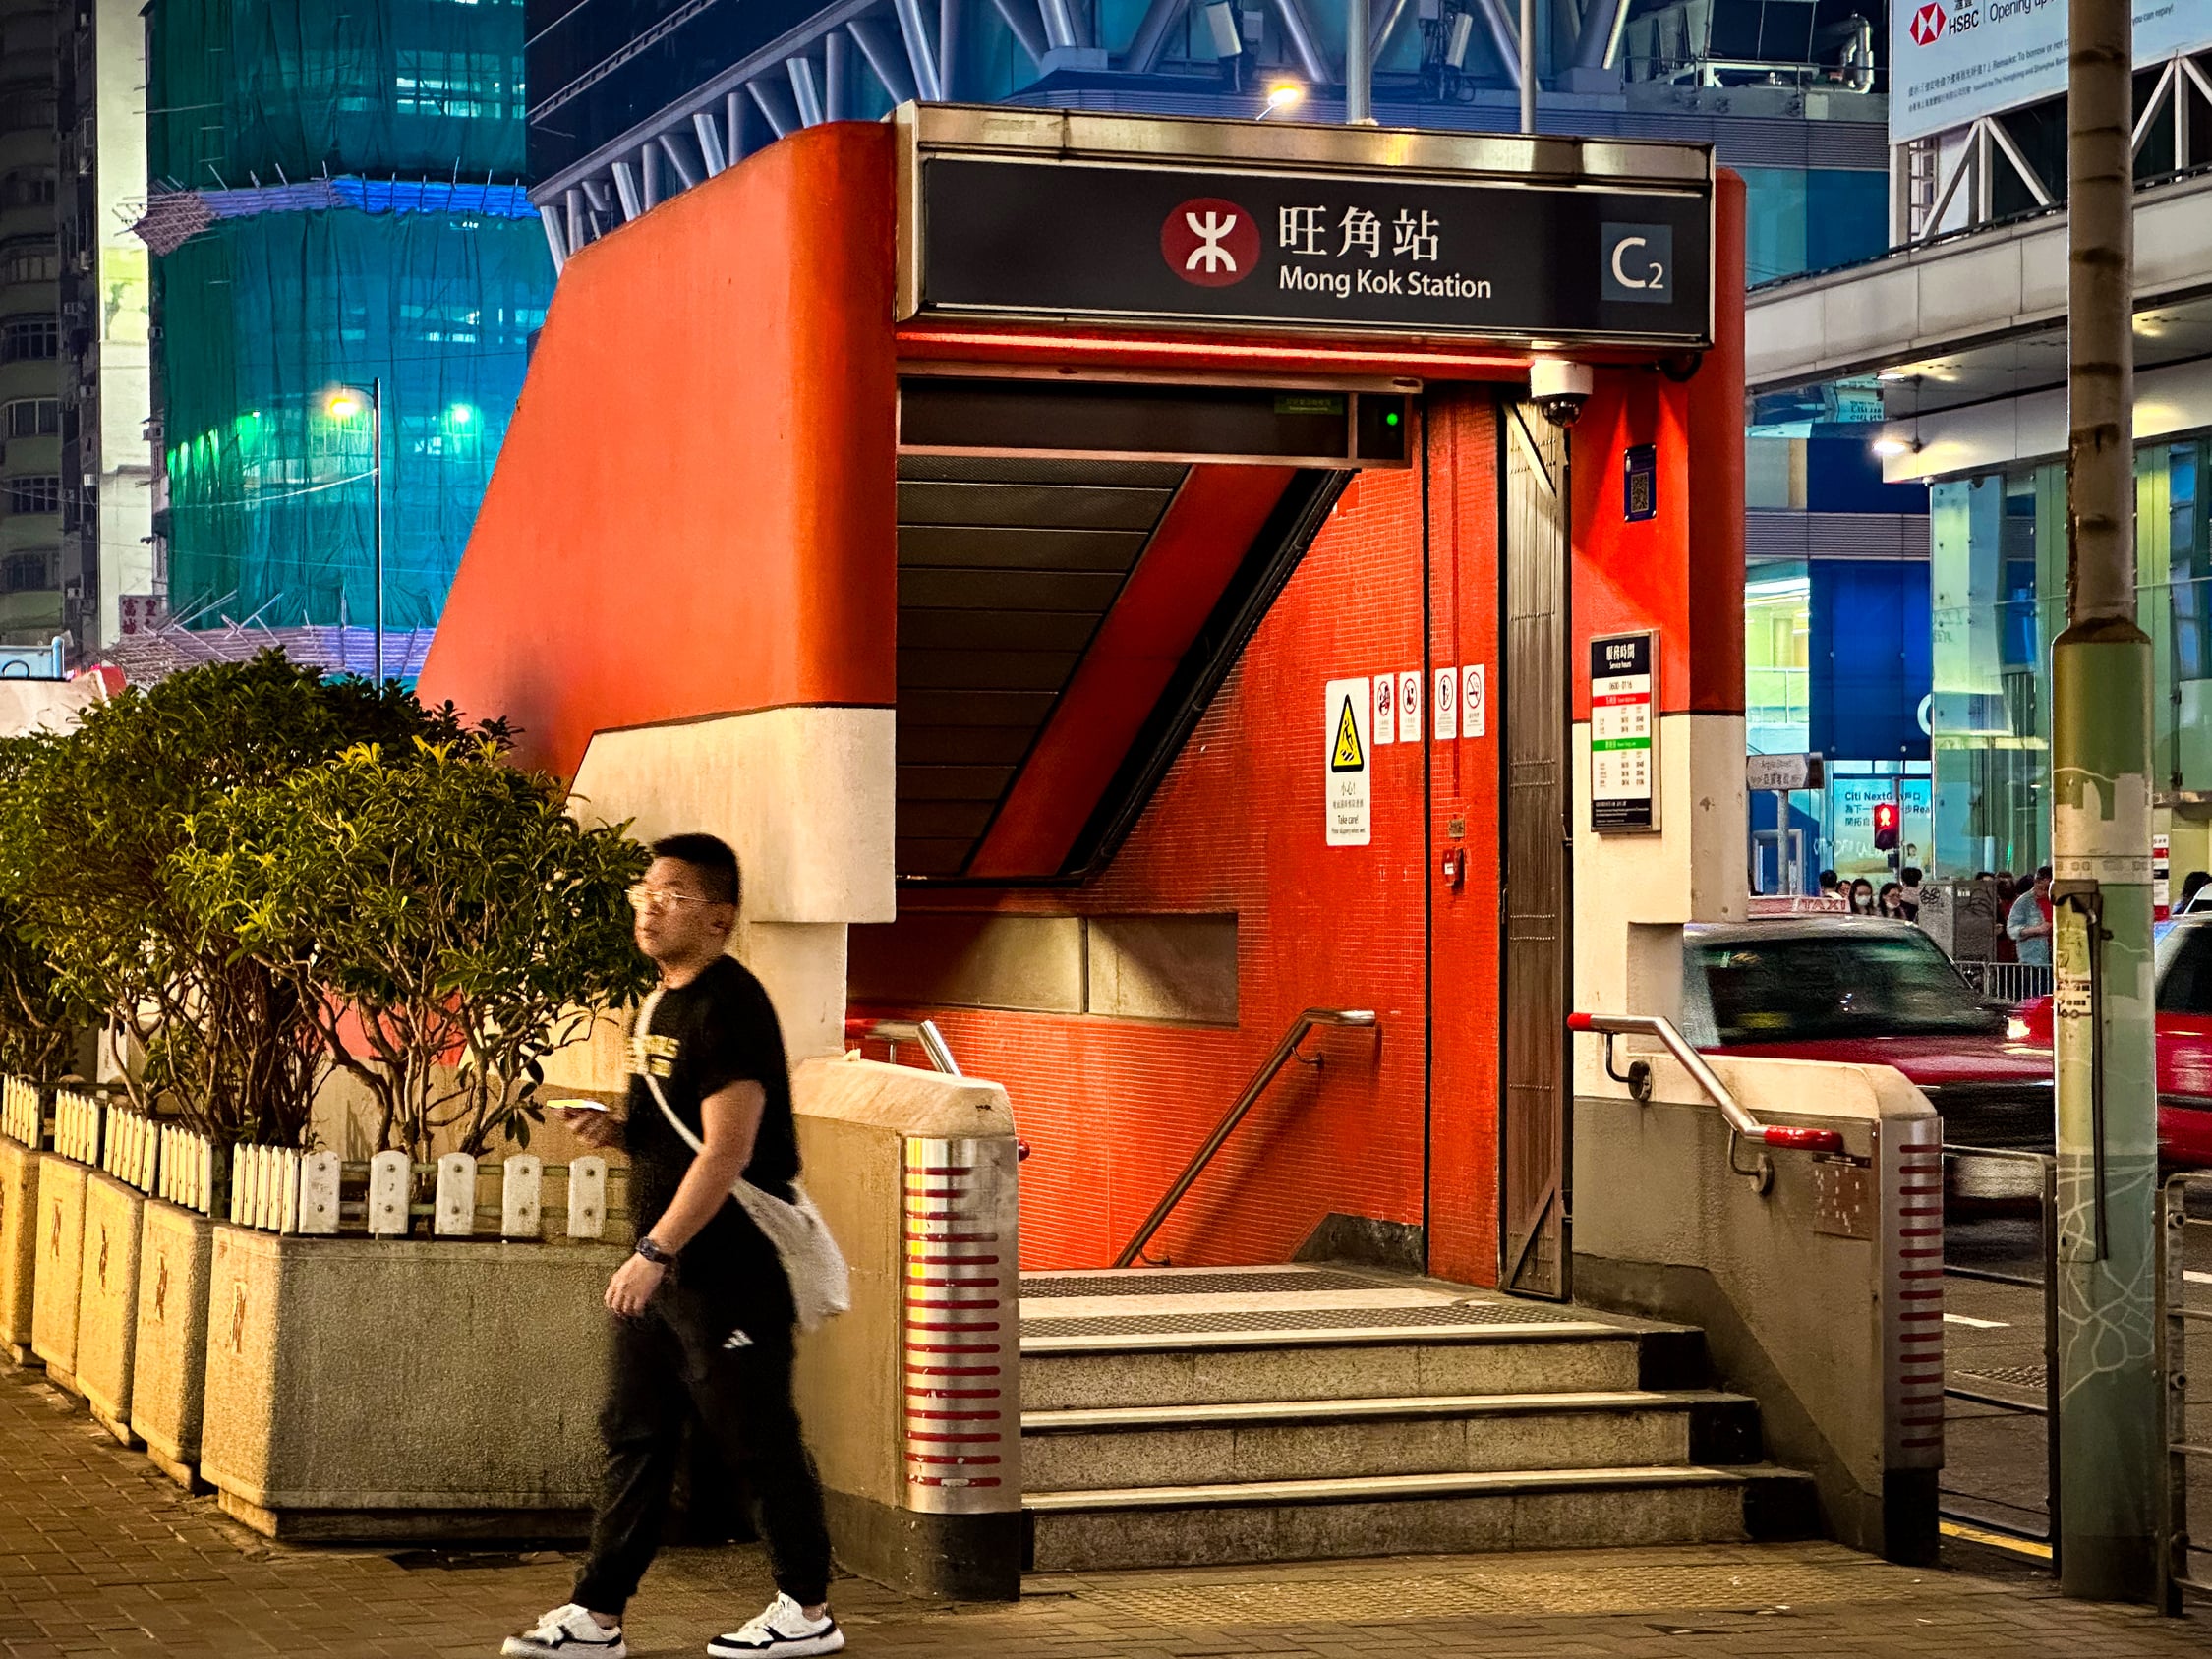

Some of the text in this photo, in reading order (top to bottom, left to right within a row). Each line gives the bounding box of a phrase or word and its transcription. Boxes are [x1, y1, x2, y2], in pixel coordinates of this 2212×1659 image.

[1949, 10, 1979, 35] HSBC
[1990, 0, 2031, 23] Opening
[1279, 204, 1440, 261] 旺角站
[1612, 236, 1663, 289] C2
[1279, 264, 1491, 298] Mong Kok Station
[1845, 792, 1861, 801] Citi
[1801, 899, 1847, 910] TAXI
